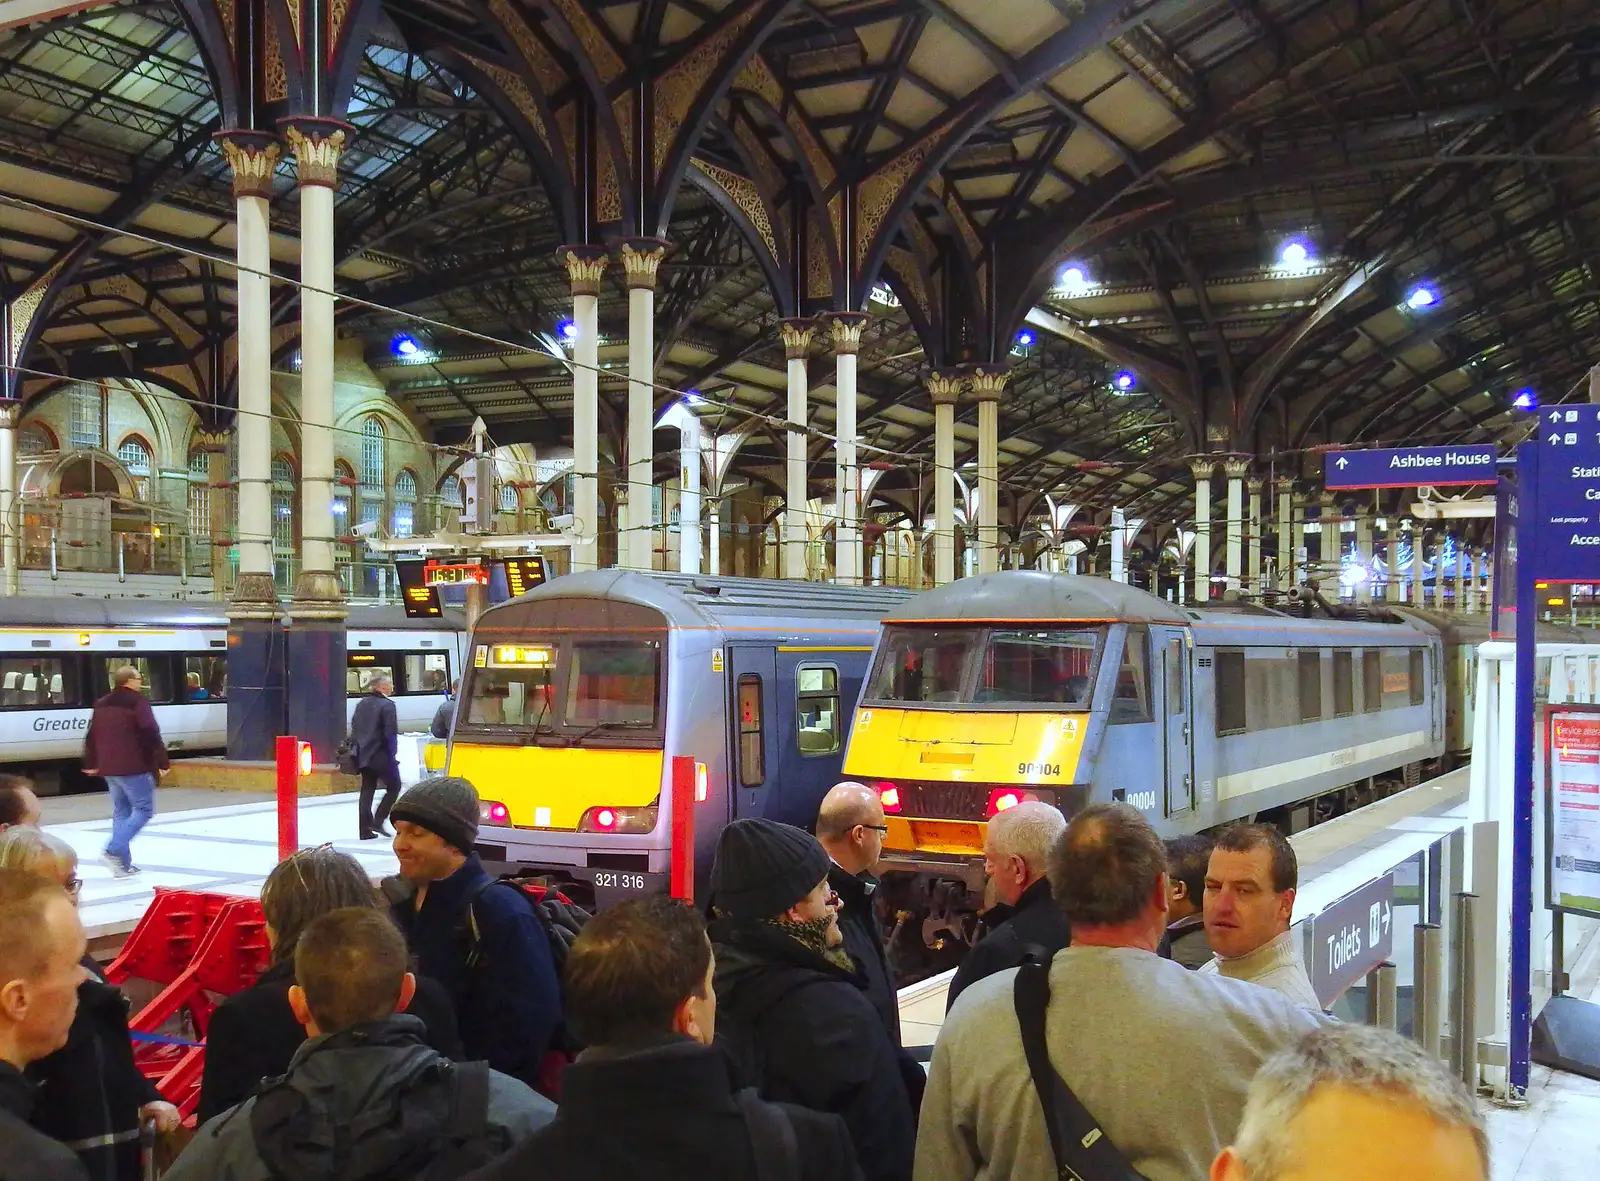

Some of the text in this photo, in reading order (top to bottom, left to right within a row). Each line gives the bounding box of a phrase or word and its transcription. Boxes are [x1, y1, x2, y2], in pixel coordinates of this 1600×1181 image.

[1389, 452, 1490, 468] Ashbee House
[595, 873, 644, 889] 321 316
[1327, 924, 1361, 974] Toilets
